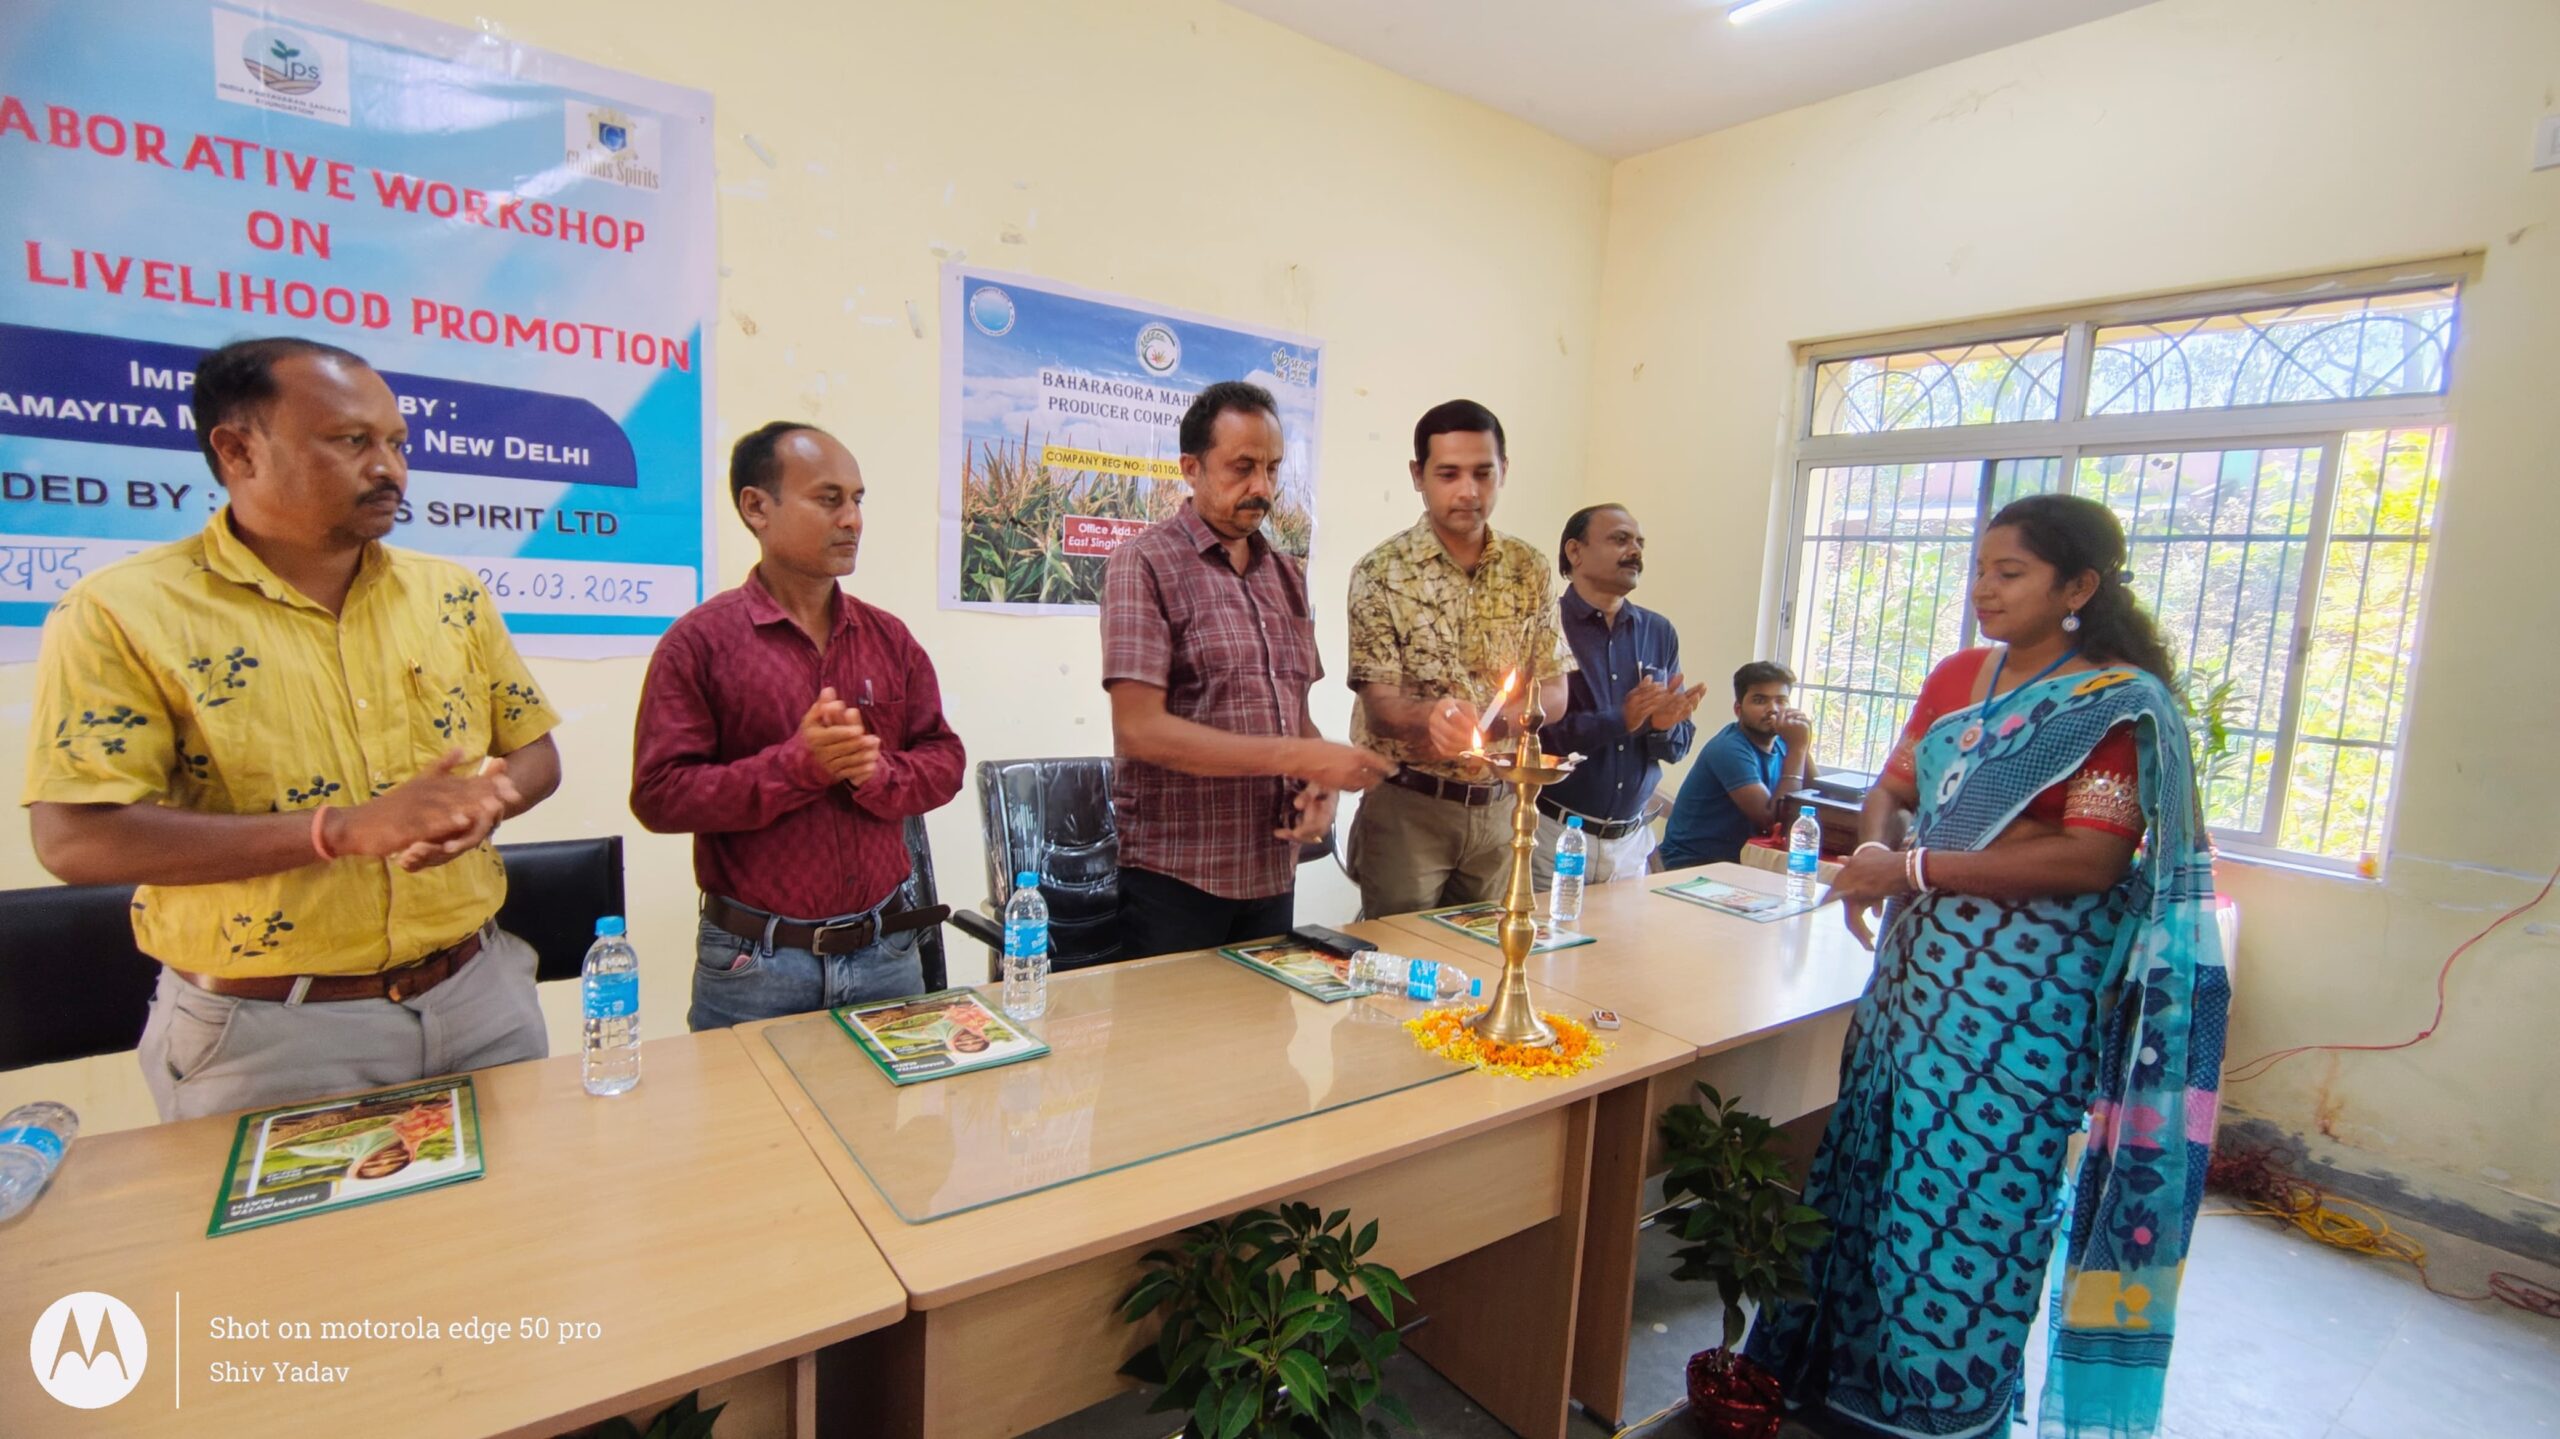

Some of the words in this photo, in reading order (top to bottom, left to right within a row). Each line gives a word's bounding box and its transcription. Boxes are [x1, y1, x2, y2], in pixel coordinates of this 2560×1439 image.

[617, 160, 659, 189] Spirits
[371, 168, 645, 252] WORKSHOP
[247, 209, 331, 260] ON
[24, 240, 391, 330] LIVELIHOOD
[411, 298, 690, 371] PROMOTION
[1043, 372, 1154, 402] BAHARAGORA
[1049, 396, 1129, 421] PRODUCER
[1046, 451, 1099, 467] COMPANY
[1102, 457, 1121, 469] REG
[127, 481, 192, 512] BY
[427, 501, 544, 531] SPIRIT
[556, 510, 618, 536] LTD
[1078, 523, 1109, 535] Office
[1068, 535, 1089, 547] East
[478, 567, 653, 606] 26.03.2025
